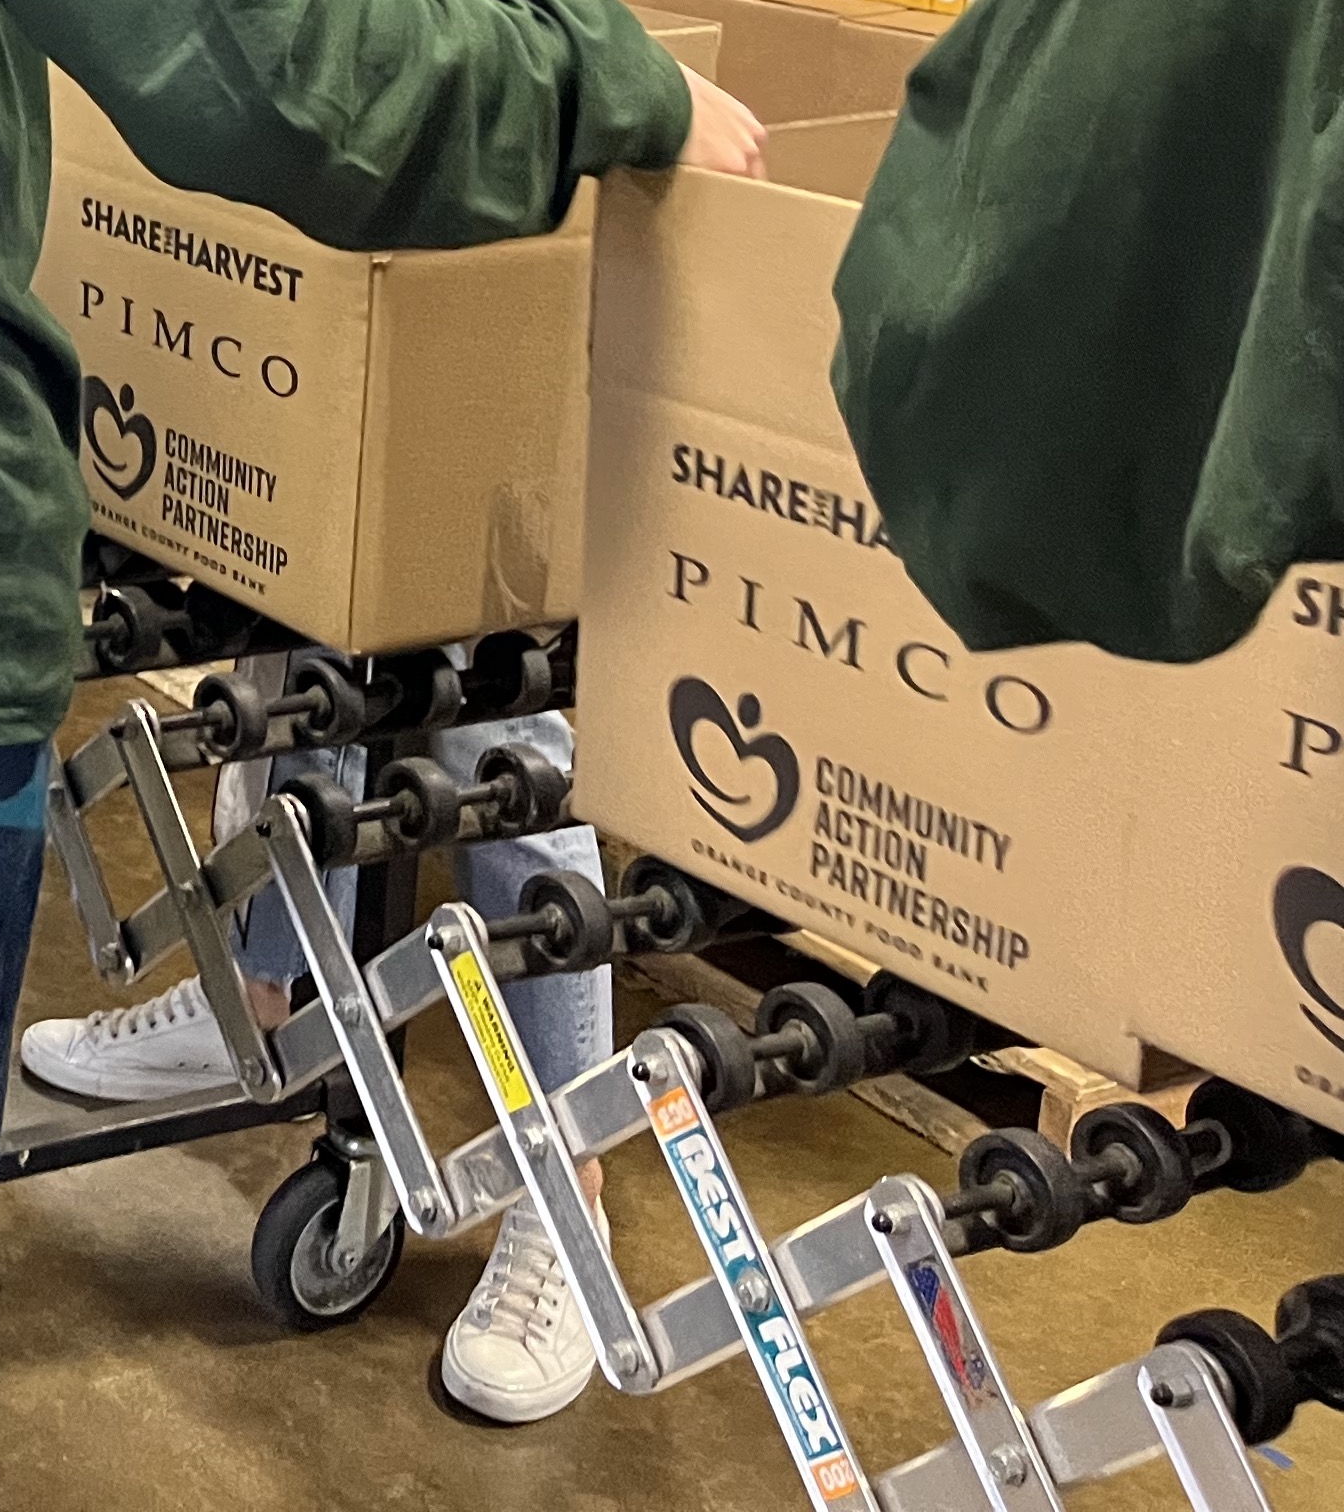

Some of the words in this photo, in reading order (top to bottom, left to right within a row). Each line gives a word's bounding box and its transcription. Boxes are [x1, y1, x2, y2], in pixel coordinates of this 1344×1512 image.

[81, 197, 163, 252] SHARE
[173, 231, 304, 303] HARVEST
[79, 280, 300, 398] PIMCO
[163, 469, 230, 516] ACTION
[164, 427, 278, 504] COMMUNITY
[672, 442, 813, 524] SHARE
[140, 524, 189, 557] COUNTY
[193, 550, 228, 576] FOOD
[232, 569, 267, 596] BANK
[162, 494, 289, 577] PARTNERSHIP
[668, 549, 1053, 735] PIMCO
[815, 802, 928, 883] ACTION
[816, 755, 1012, 874] COMMUNITY
[775, 878, 857, 928] COUNTY
[864, 919, 924, 961] FOOD
[932, 954, 990, 993] BANK
[812, 840, 1031, 969] PARTNERSHIP
[676, 1133, 756, 1267] BEST
[757, 1315, 839, 1455] FLEX
